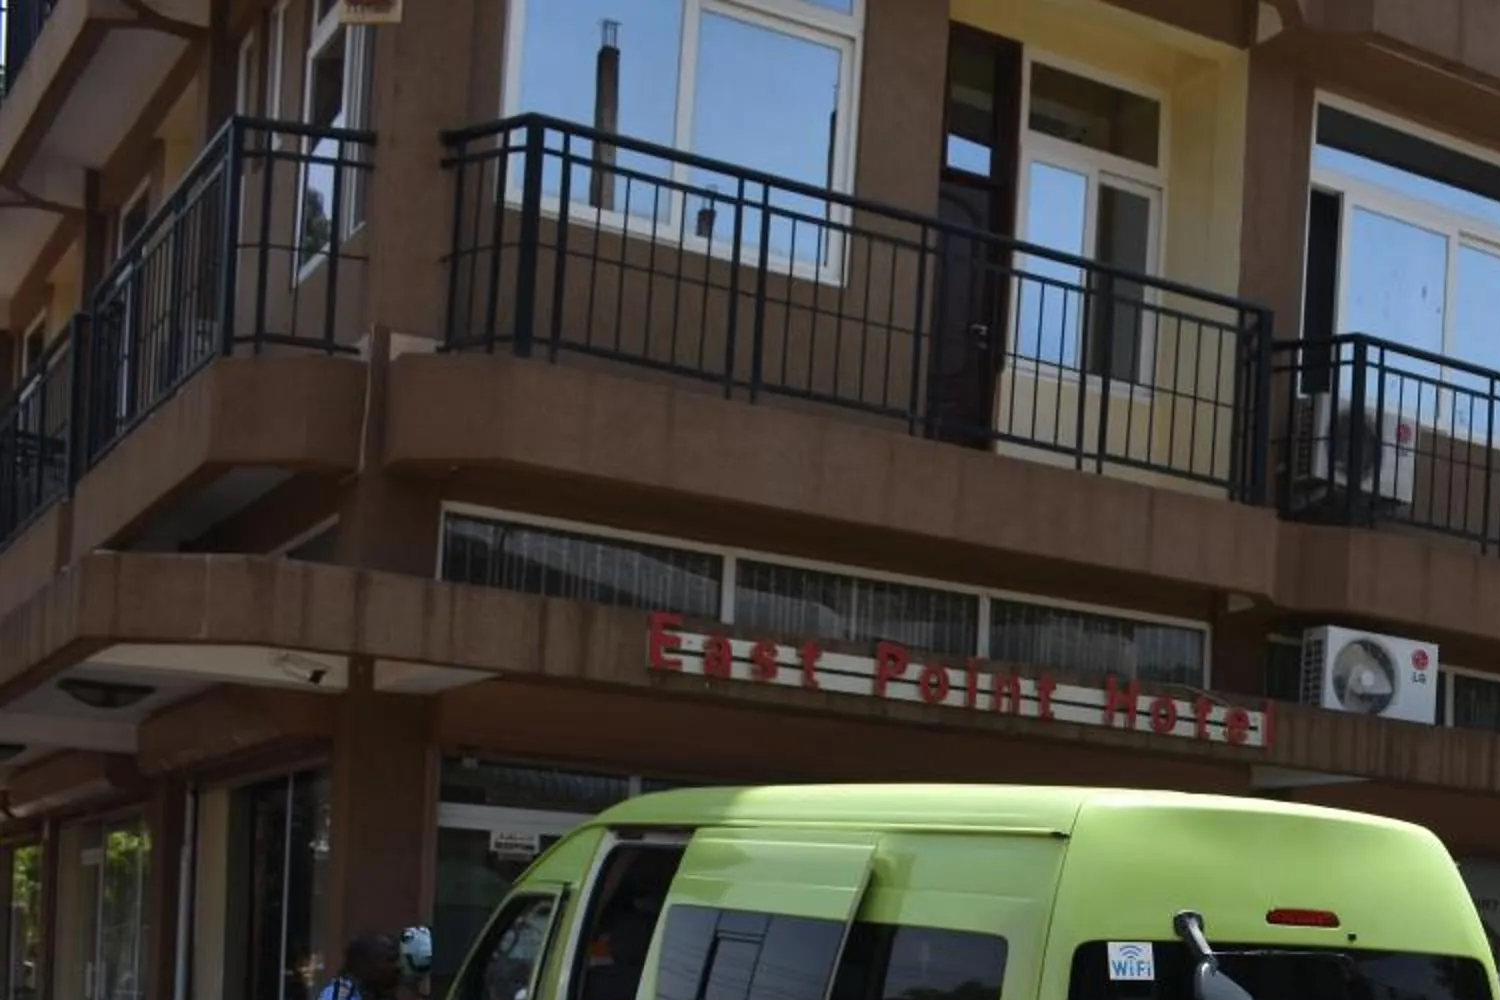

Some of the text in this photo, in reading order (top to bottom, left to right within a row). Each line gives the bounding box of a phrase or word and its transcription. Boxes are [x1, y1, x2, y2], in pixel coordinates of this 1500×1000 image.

[648, 611, 1276, 750] East Point Hotel
[1412, 671, 1426, 685] LG
[1111, 959, 1151, 977] WiFi
